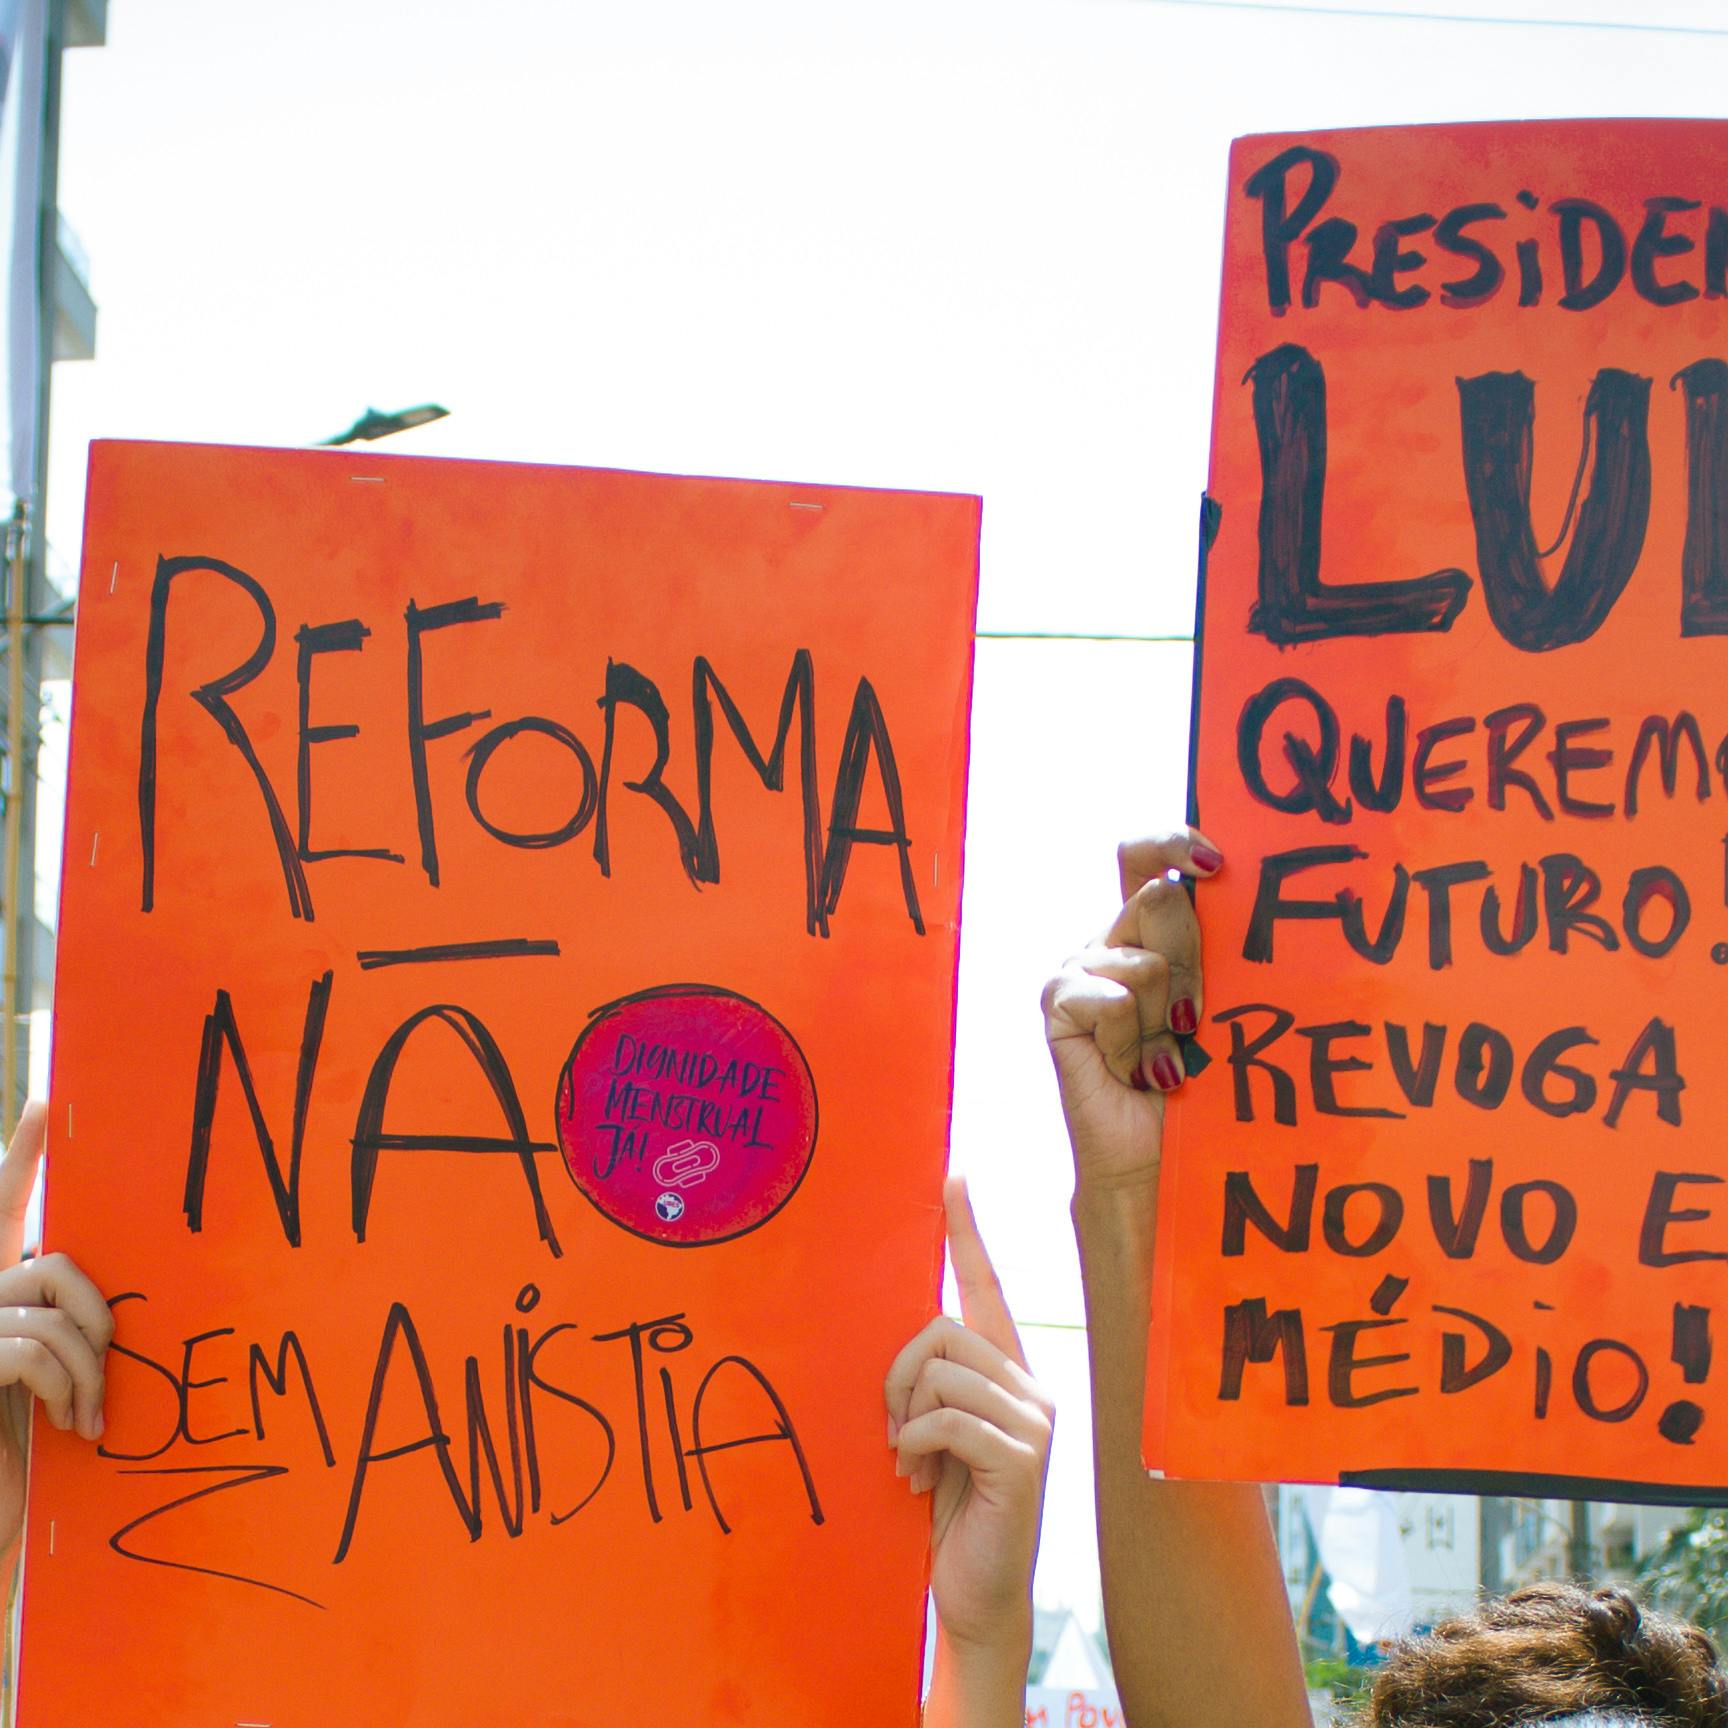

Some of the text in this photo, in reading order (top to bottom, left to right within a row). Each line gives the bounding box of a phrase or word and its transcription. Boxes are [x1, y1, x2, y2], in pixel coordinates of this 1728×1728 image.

[138, 552, 927, 940] REFORMA
[604, 1078, 774, 1150] MENSTRUAL
[1212, 1003, 1687, 1129] REVOGA
[1220, 1157, 1579, 1267] NOVO
[98, 1291, 336, 1469] SEM
